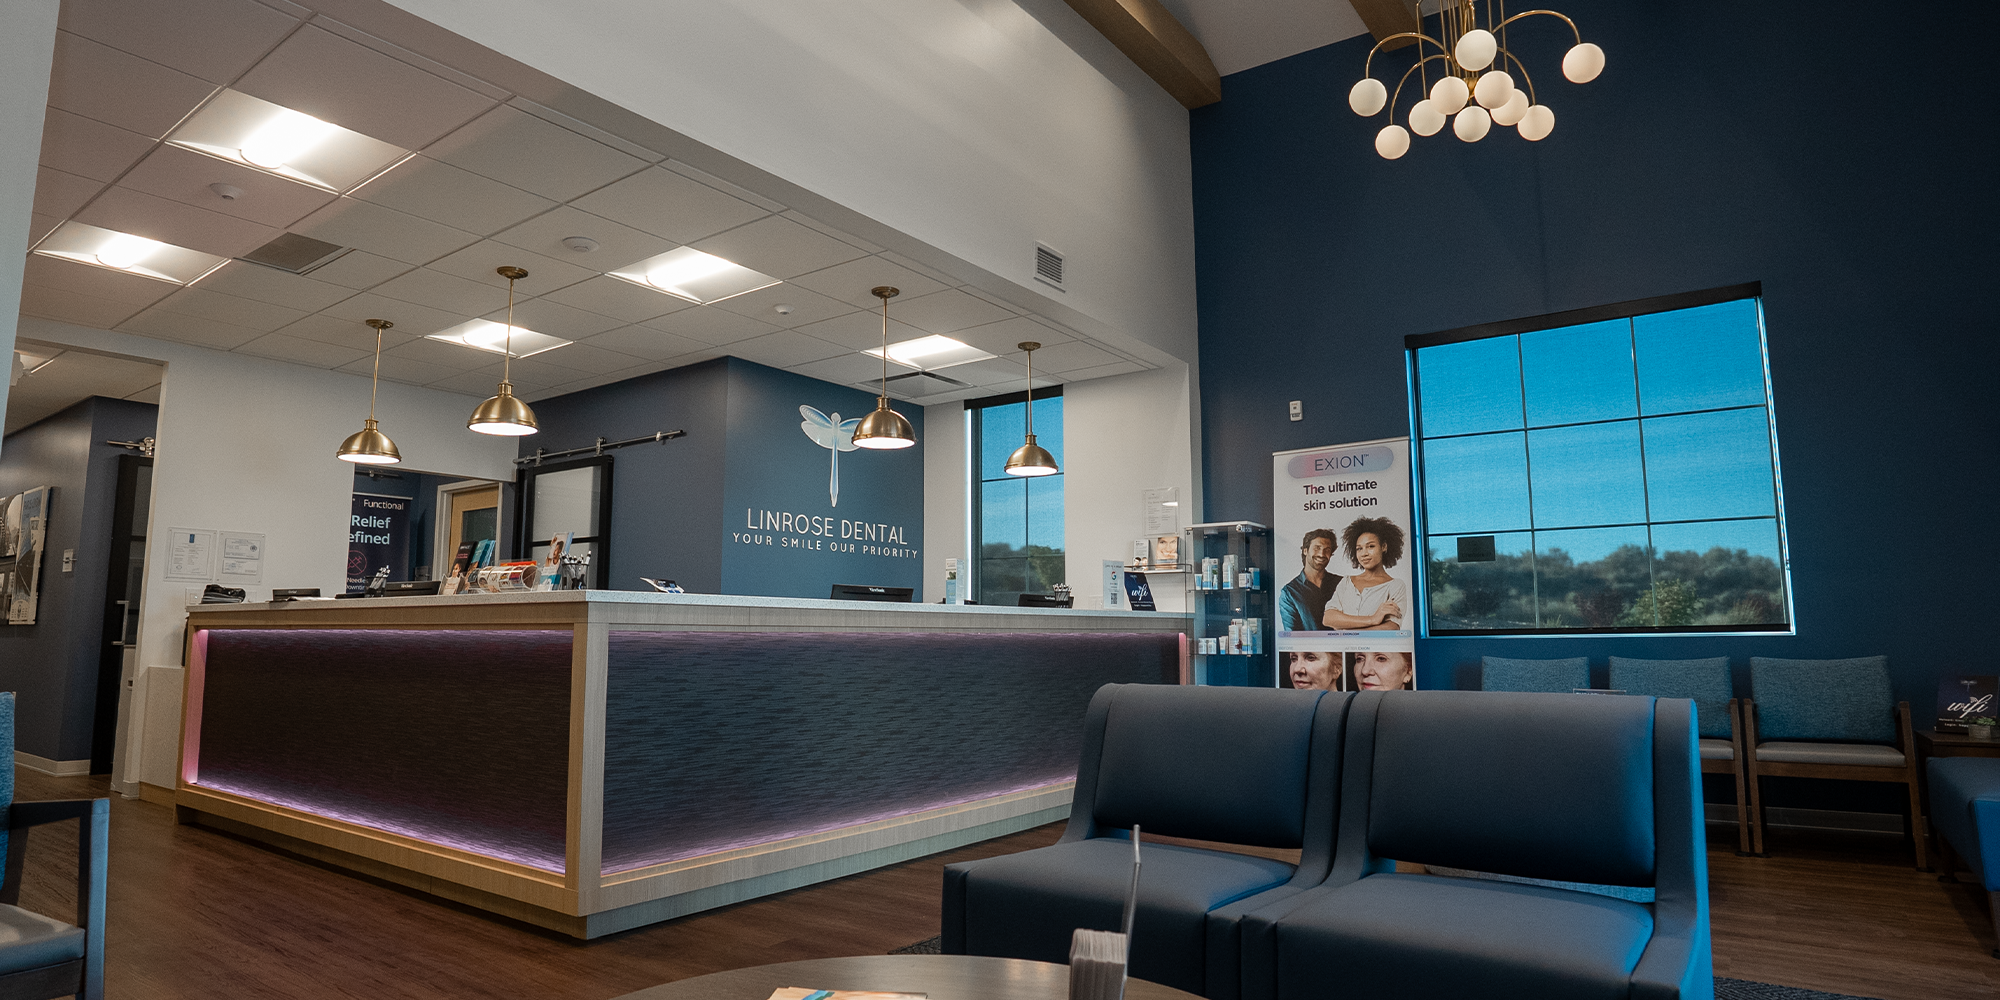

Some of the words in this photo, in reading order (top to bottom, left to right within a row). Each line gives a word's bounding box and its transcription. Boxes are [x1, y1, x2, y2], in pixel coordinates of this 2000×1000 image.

[1303, 484, 1325, 495] The
[1328, 479, 1378, 493] ultimate
[363, 499, 404, 510] Functional
[1303, 499, 1326, 511] skin
[1329, 495, 1378, 509] solution
[351, 514, 391, 529] Relief
[747, 508, 834, 537] LINROSE
[841, 519, 908, 545] DENTAL
[349, 531, 390, 545] efined
[733, 532, 772, 546] YOUR
[781, 537, 821, 551] SMILE
[829, 541, 855, 553] OUR
[863, 545, 917, 559] PRIORITY
[1947, 693, 1993, 719] wifi
